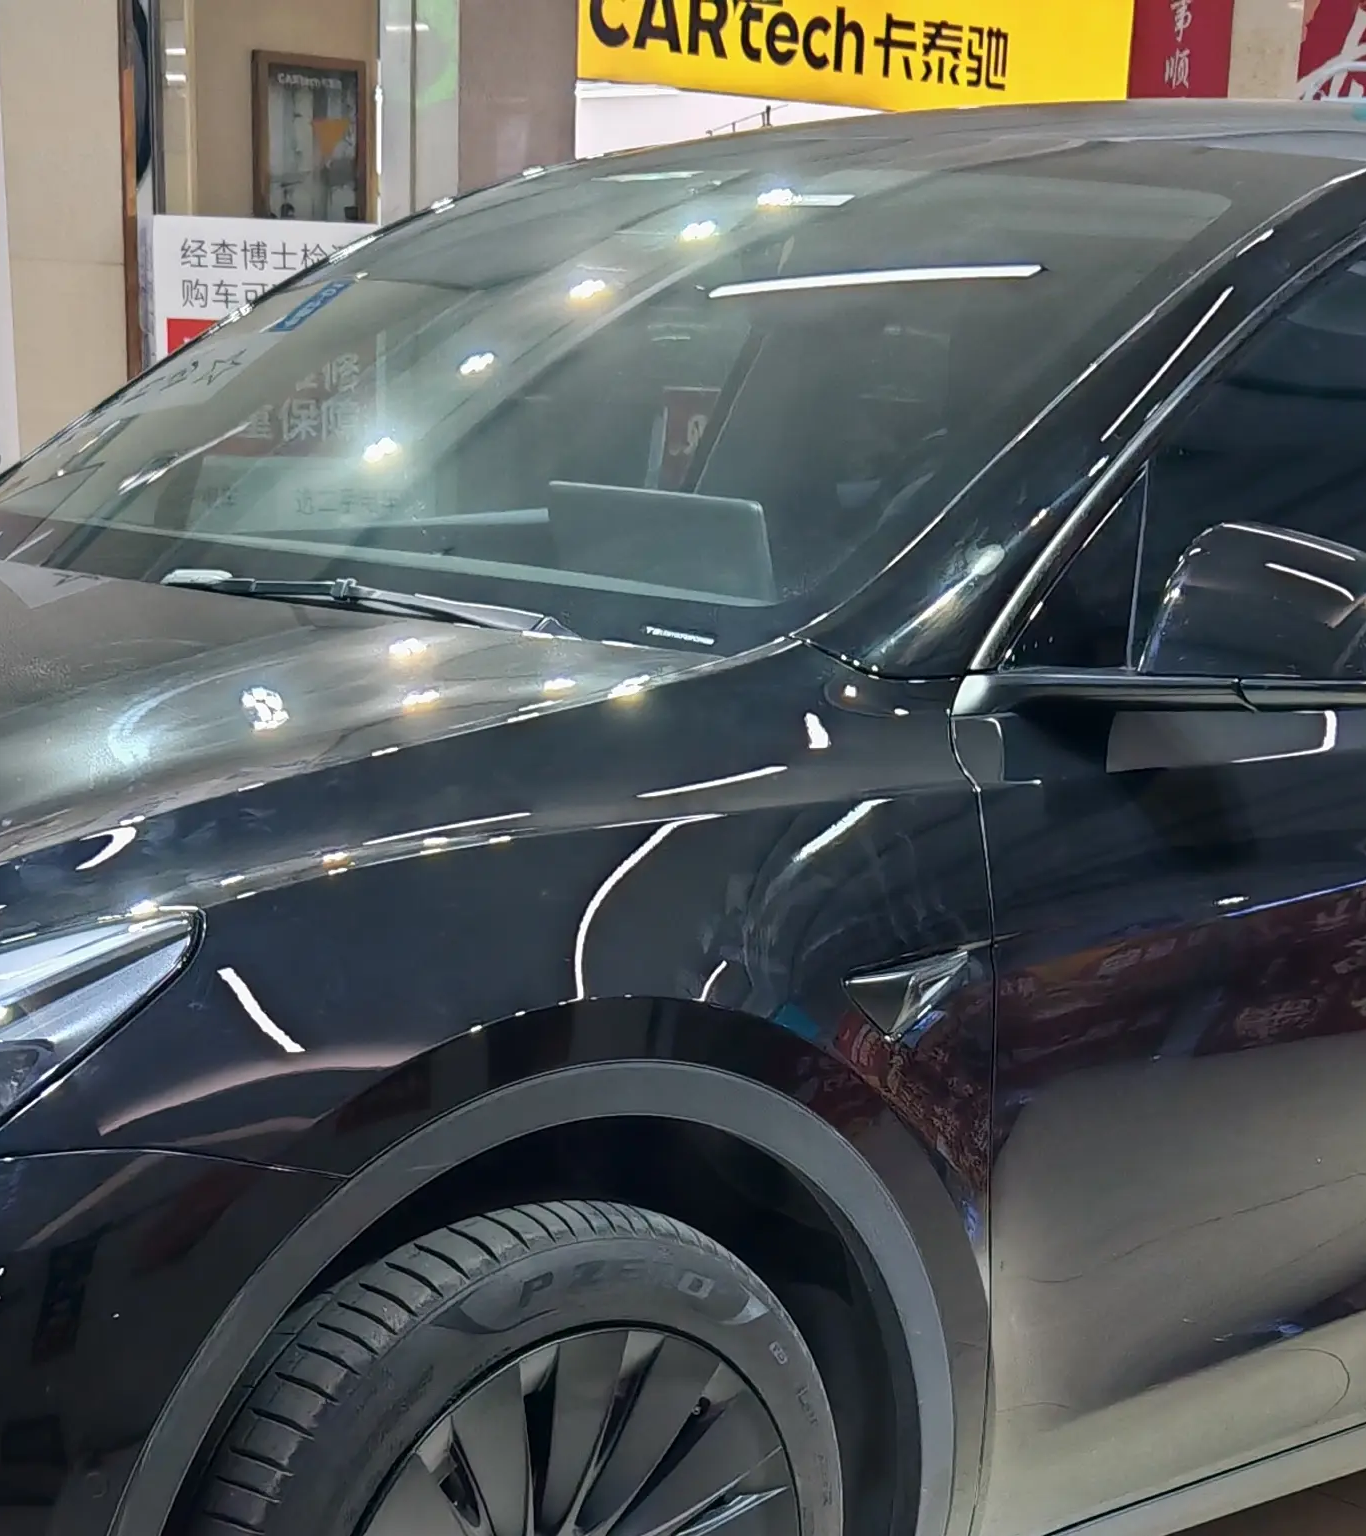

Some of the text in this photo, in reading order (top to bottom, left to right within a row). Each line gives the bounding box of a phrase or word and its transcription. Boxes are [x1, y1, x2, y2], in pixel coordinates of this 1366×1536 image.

[874, 13, 1010, 90] 卡泰驰
[180, 237, 347, 272] 经查博士检
[181, 278, 277, 310] 购车可
